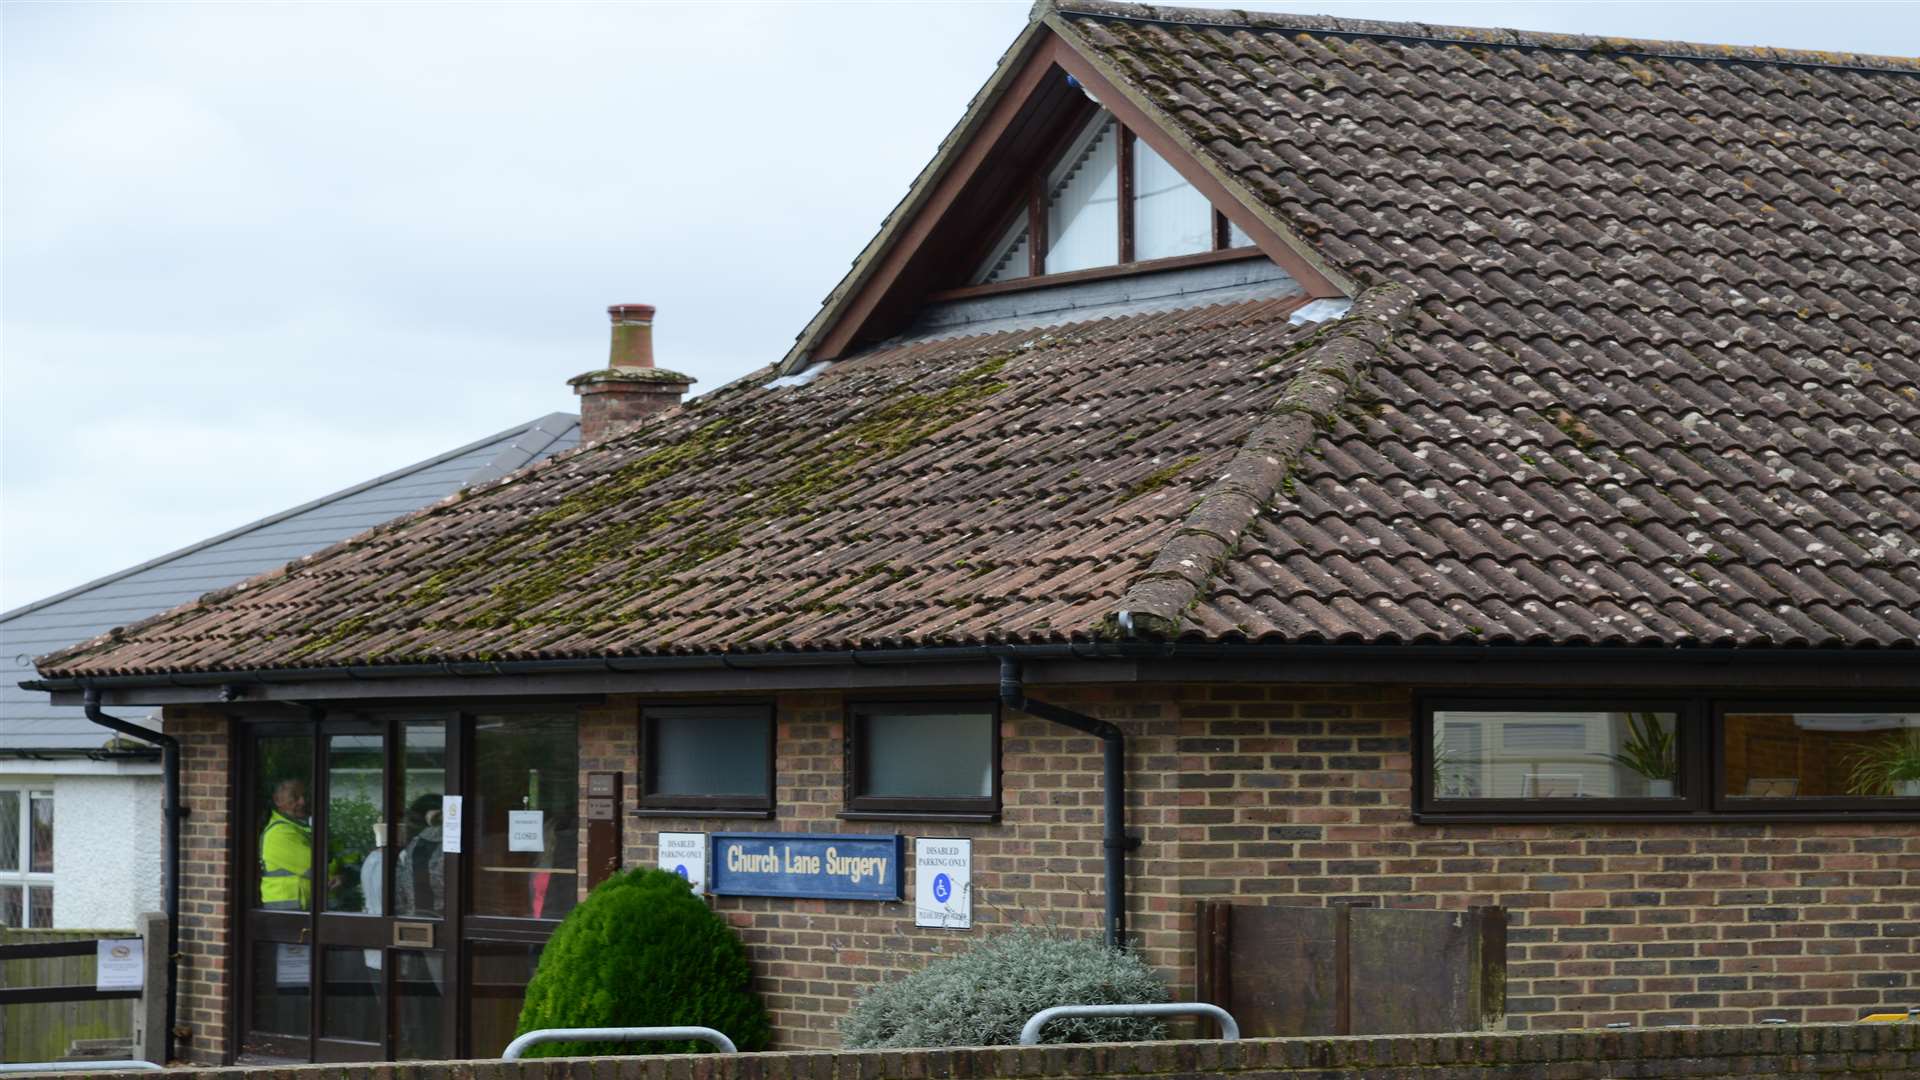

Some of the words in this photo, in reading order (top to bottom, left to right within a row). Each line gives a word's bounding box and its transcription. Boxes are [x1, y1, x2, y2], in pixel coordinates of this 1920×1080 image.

[926, 847, 959, 856] DISABLED
[727, 845, 779, 873] Church
[785, 846, 820, 875] Lane
[826, 847, 887, 884] Surgery
[919, 857, 947, 867] PARKING
[948, 858, 967, 868] ONLY
